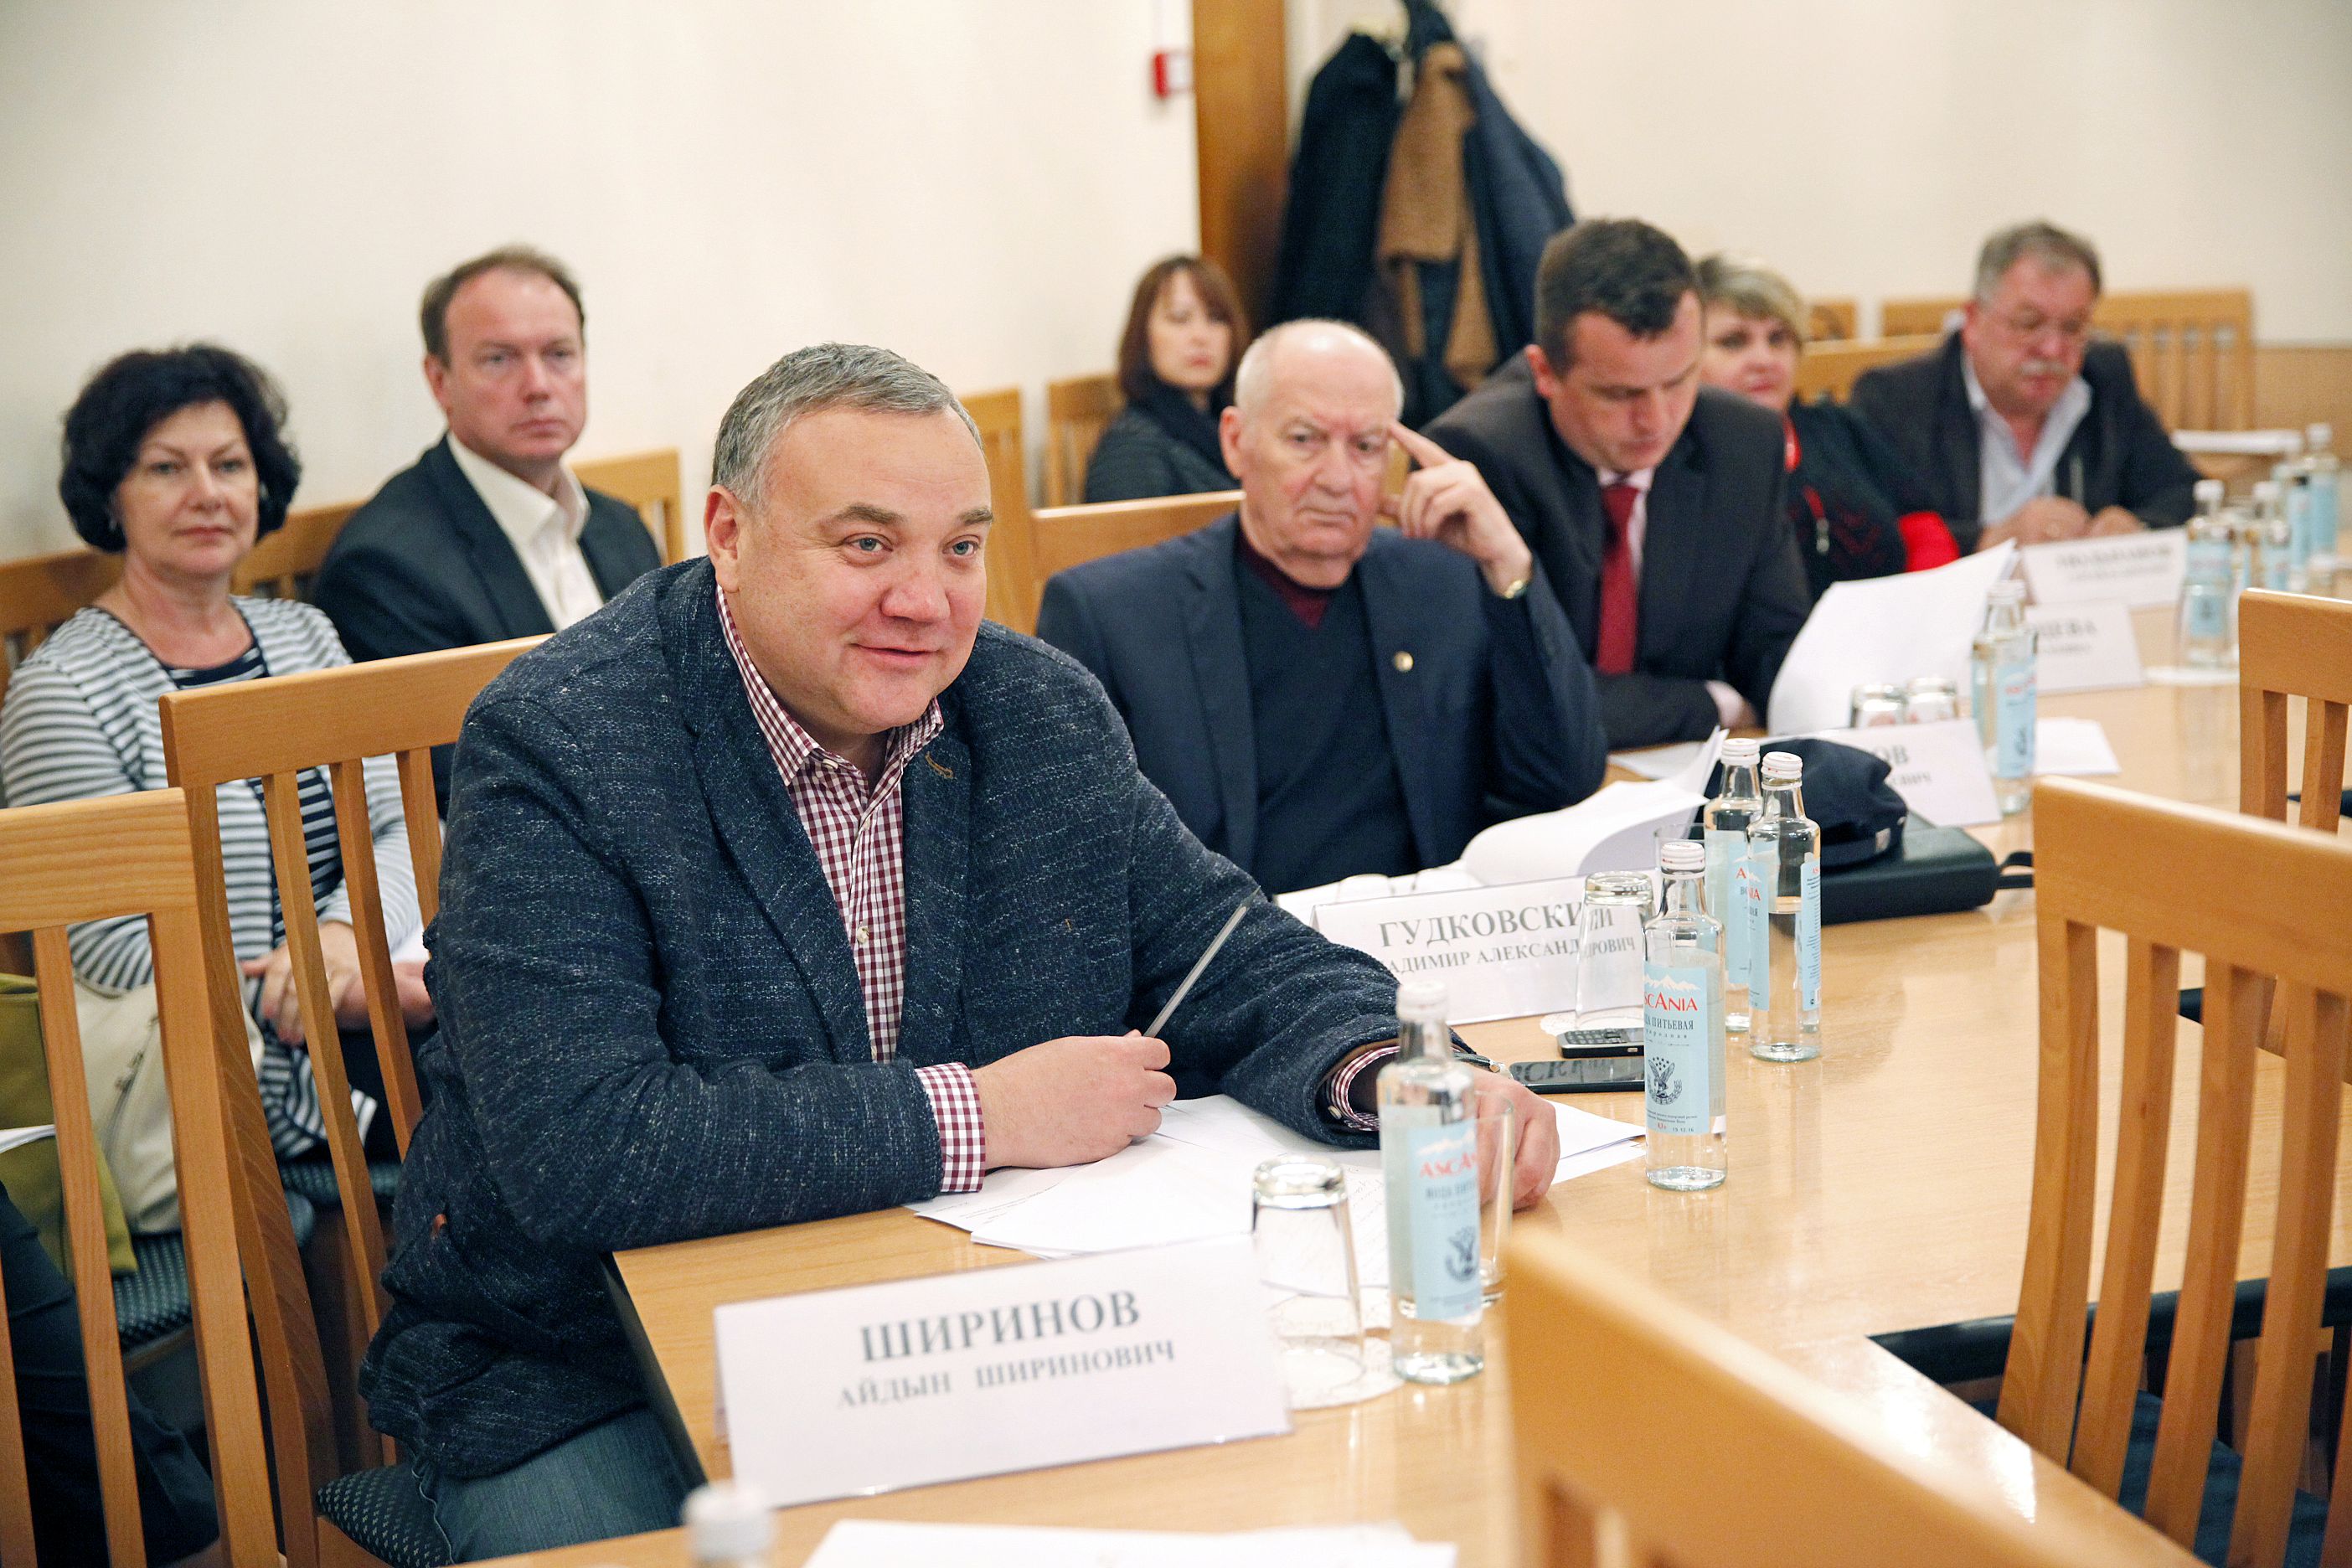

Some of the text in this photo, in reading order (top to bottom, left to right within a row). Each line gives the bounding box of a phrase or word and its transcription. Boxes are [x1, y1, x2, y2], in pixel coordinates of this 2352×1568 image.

[1387, 951, 1471, 975] АДИМИР
[1644, 992, 1698, 1011] SCANIA
[1652, 1016, 1694, 1030] ПИТЬЕВАЯ
[1420, 1152, 1476, 1180] ASCA
[860, 1290, 1141, 1363] ШИРИНОВ
[838, 1339, 1176, 1409] АЙДЫН ШИРИНОВИЧ
